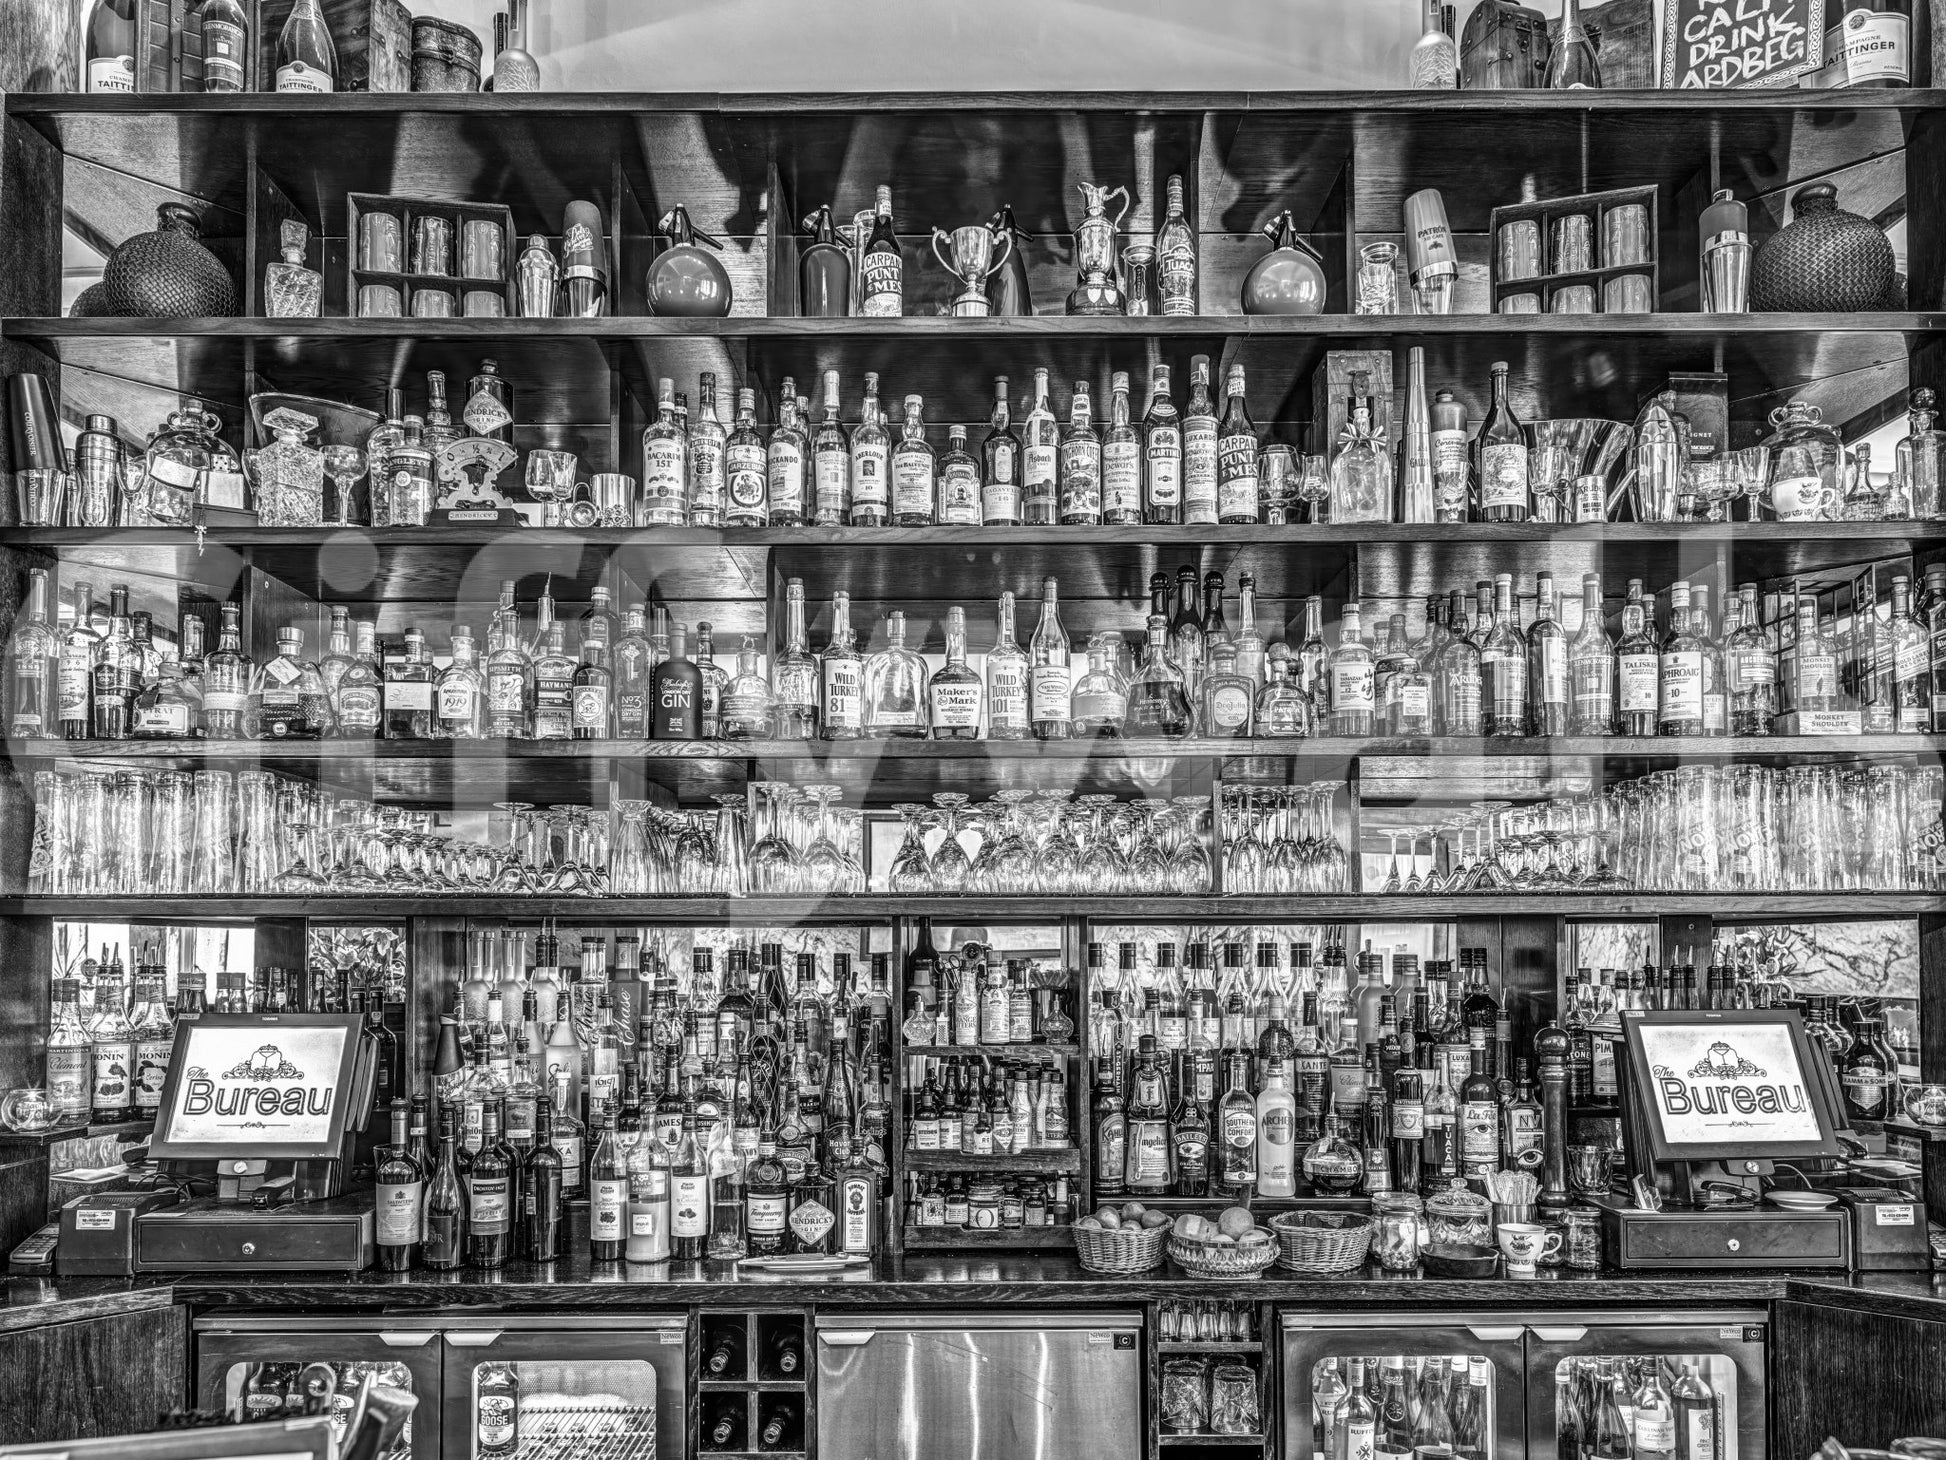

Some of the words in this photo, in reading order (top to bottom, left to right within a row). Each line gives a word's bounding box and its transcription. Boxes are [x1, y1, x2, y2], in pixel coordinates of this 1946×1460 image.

[1684, 0, 1794, 42] CAL
[1690, 4, 1798, 68] DRINK
[1679, 26, 1806, 88] ARDBEG
[1823, 41, 1896, 68] TAITTINGER
[279, 84, 323, 92] TAITTINGER
[1166, 259, 1194, 271] TUACA
[866, 268, 899, 284] PUNT
[1185, 433, 1217, 442] LUXARDO
[855, 451, 883, 461] ABERLOUR
[1029, 455, 1051, 463] Asbach
[1221, 451, 1254, 468] PUNT
[835, 673, 855, 685] WILD
[995, 674, 1017, 686] WILD
[1660, 668, 1699, 680] APHROAIG
[829, 684, 858, 697] TURKEY
[937, 688, 978, 696] Maker's
[991, 685, 1021, 698] TURKEY
[1671, 689, 1680, 697] 10
[444, 697, 467, 706] 1919
[661, 694, 691, 708] GIN
[830, 698, 845, 712] 81
[948, 697, 977, 705] Mark
[992, 699, 1009, 714] 101
[187, 1066, 209, 1080] The
[1652, 1065, 1675, 1079] The
[183, 1079, 333, 1116] Bureau
[1661, 1077, 1807, 1117] Bureau
[1226, 1119, 1254, 1127] SOUTHERN
[1520, 1115, 1540, 1127] NV
[1228, 1128, 1254, 1136] COMFORT
[1176, 1133, 1207, 1144] BAILEYS
[847, 1184, 865, 1192] BOMBAY
[751, 1208, 782, 1217] Tanqueray
[791, 1216, 833, 1225] HENDRICK'S
[481, 1414, 508, 1425] GOOSE
